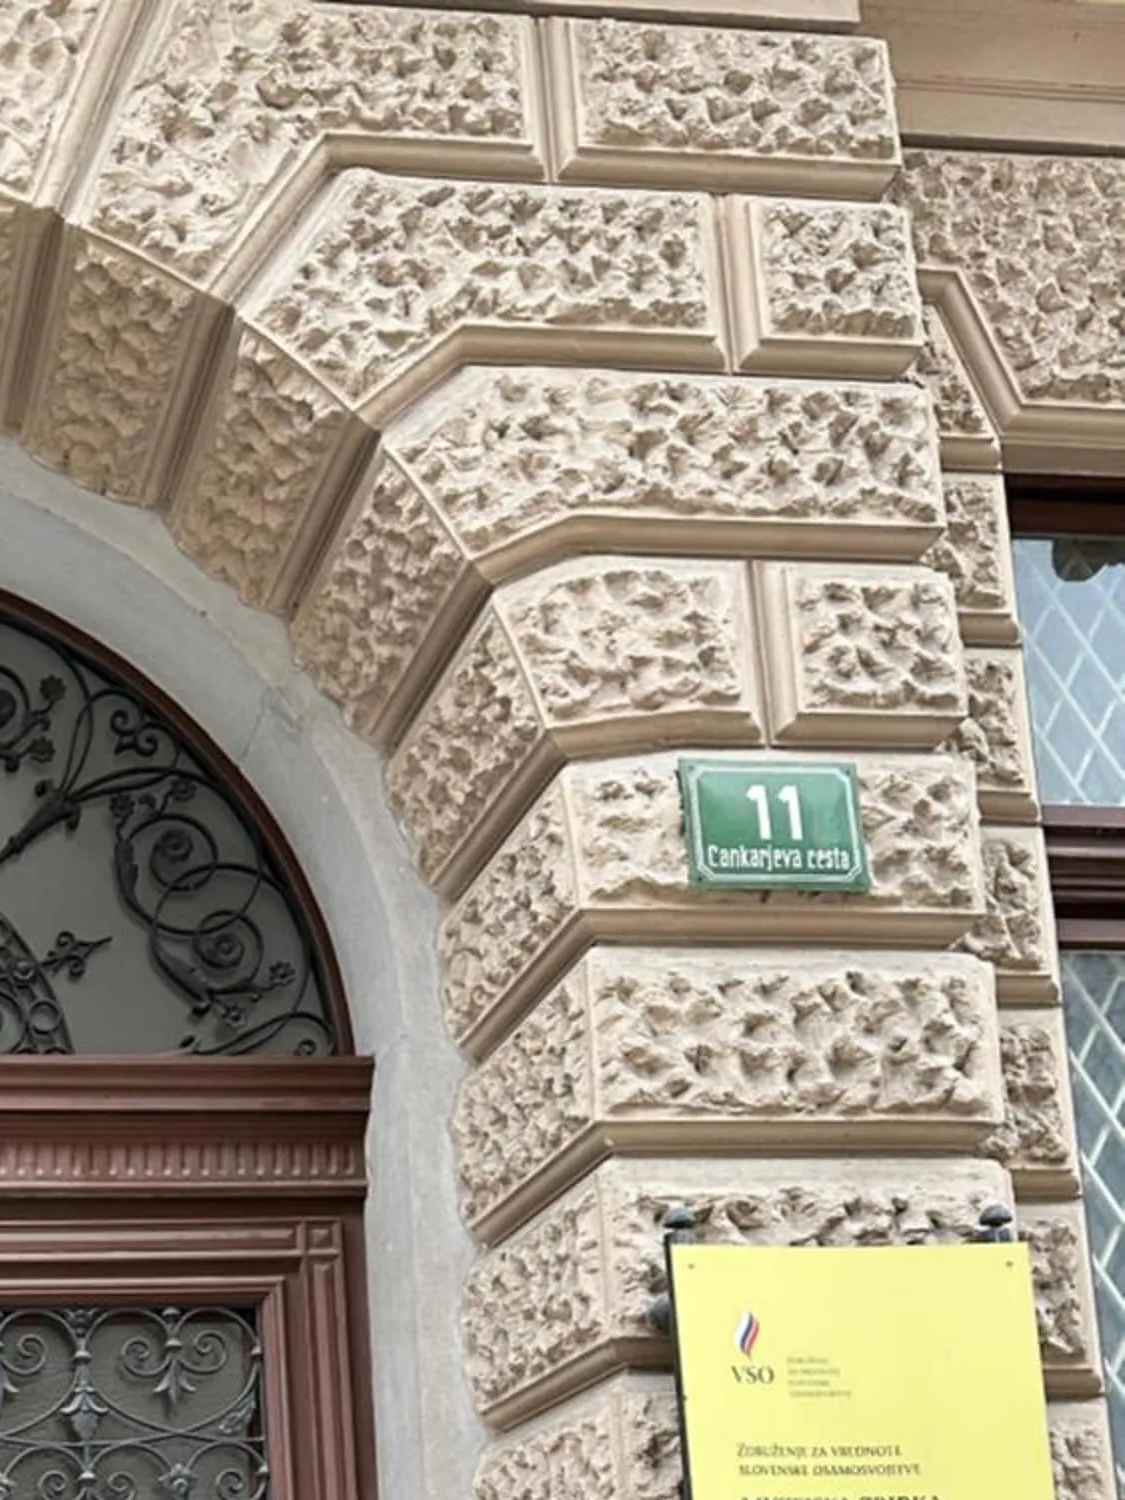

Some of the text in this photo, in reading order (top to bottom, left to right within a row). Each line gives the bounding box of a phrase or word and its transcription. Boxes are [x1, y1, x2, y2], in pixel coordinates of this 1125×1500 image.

[746, 784, 803, 840] 11
[708, 845, 850, 871] Cankarjeva cesta
[731, 1365, 774, 1384] VSO
[811, 1445, 827, 1457] ZA
